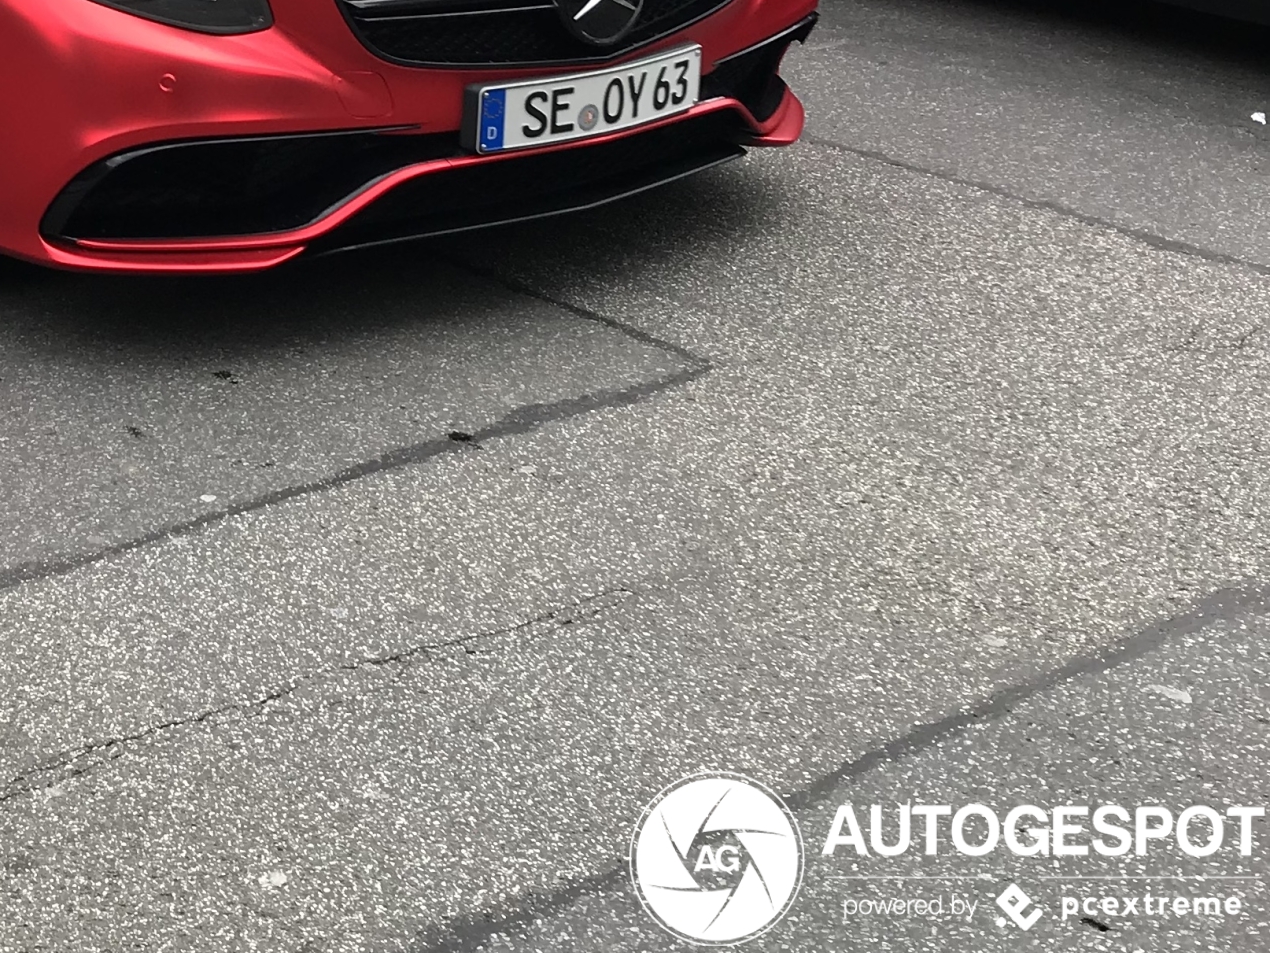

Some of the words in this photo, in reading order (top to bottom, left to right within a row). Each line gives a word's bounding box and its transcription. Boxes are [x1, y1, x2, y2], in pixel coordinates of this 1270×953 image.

[487, 126, 497, 140] D
[522, 87, 575, 138] SE
[603, 72, 648, 124] OY
[653, 59, 690, 111] 63
